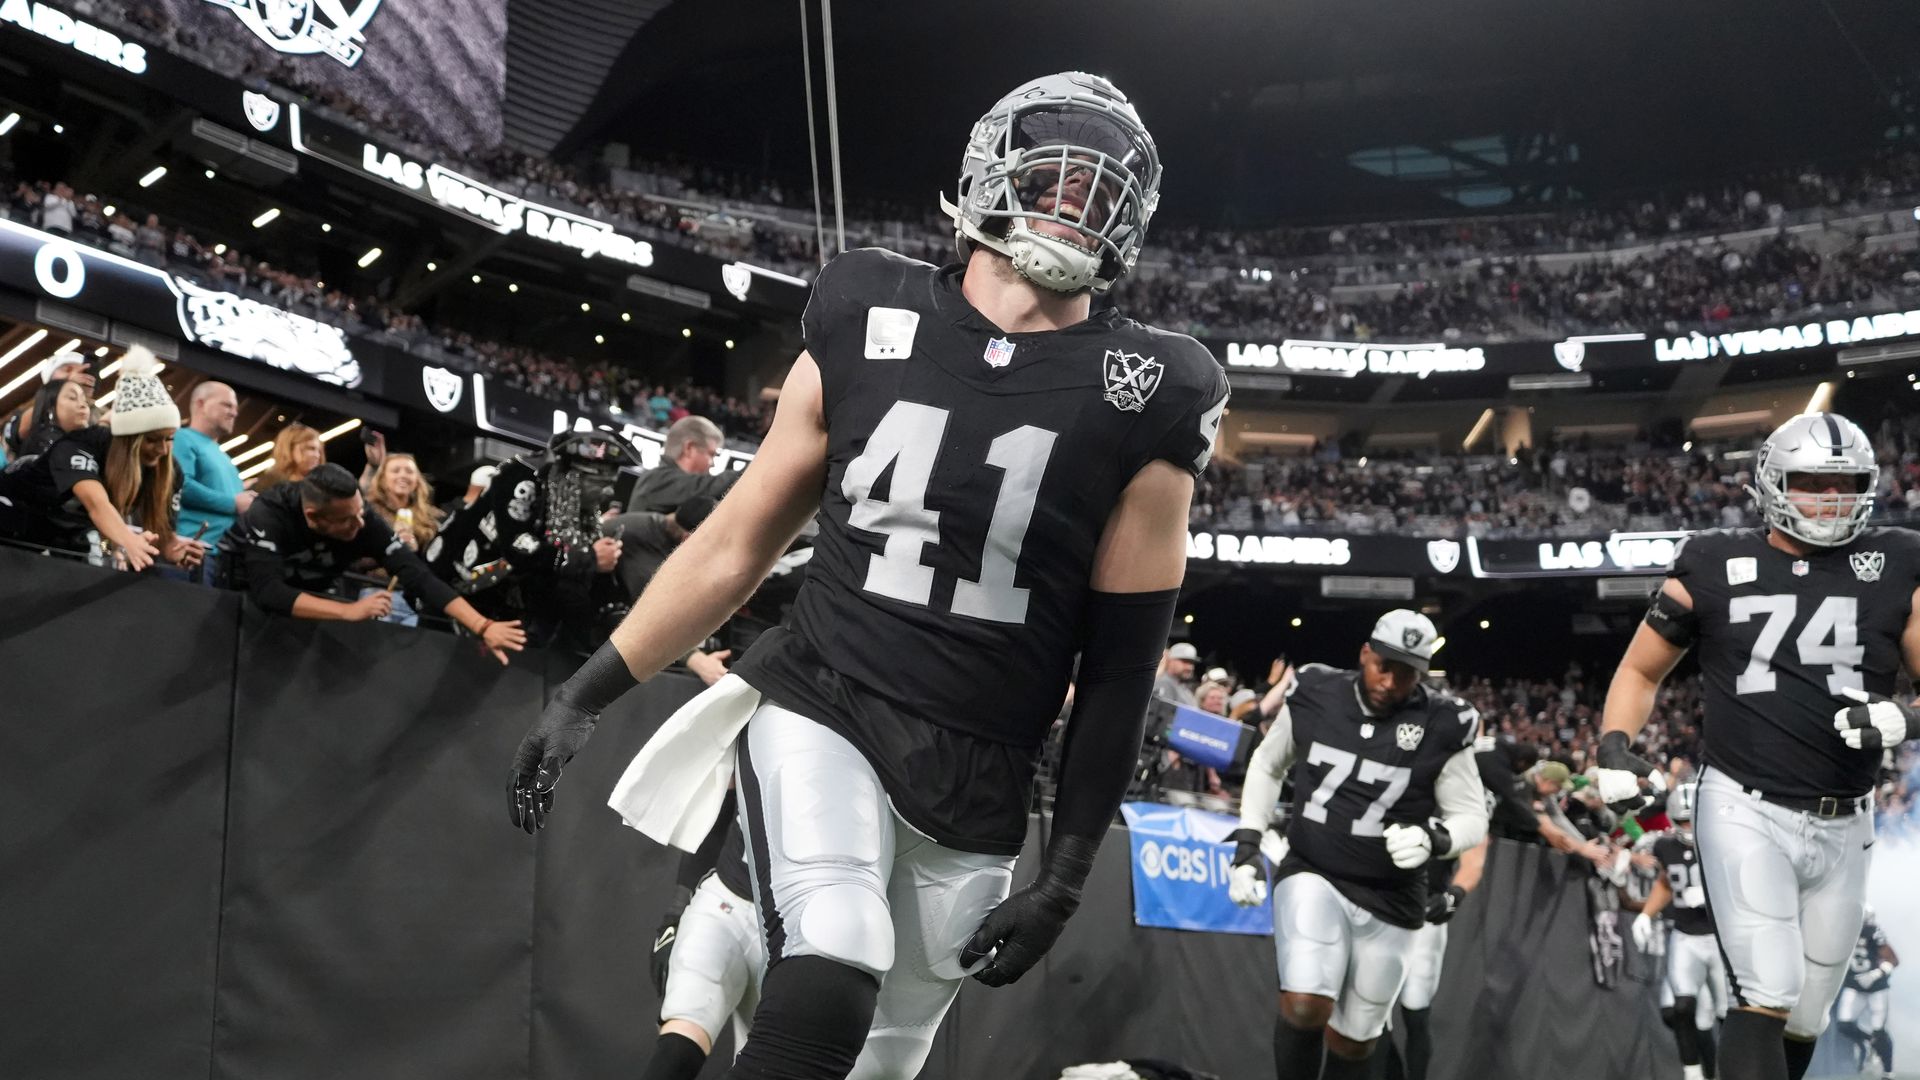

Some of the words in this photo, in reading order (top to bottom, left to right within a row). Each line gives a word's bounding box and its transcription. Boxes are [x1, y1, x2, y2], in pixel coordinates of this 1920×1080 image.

[0, 0, 147, 74] AIDERS
[362, 143, 423, 190] LAS
[425, 165, 523, 231] VEGAS
[526, 209, 653, 267] RAIDERS
[34, 243, 86, 298] 0
[1227, 342, 1279, 367] LAS
[1280, 342, 1367, 373] VEGAS
[1368, 346, 1485, 374] RAIDERS
[1655, 331, 1718, 362] LAS
[1719, 322, 1824, 357] VEGAS
[1826, 309, 1920, 345] RAIDE
[840, 399, 1060, 625] 41
[1216, 534, 1351, 566] RAIDERS
[1538, 541, 1604, 570] LAS
[1605, 538, 1675, 568] VEG
[1729, 593, 1869, 696] 74
[1302, 741, 1412, 838] 77
[1161, 844, 1209, 884] CBS
